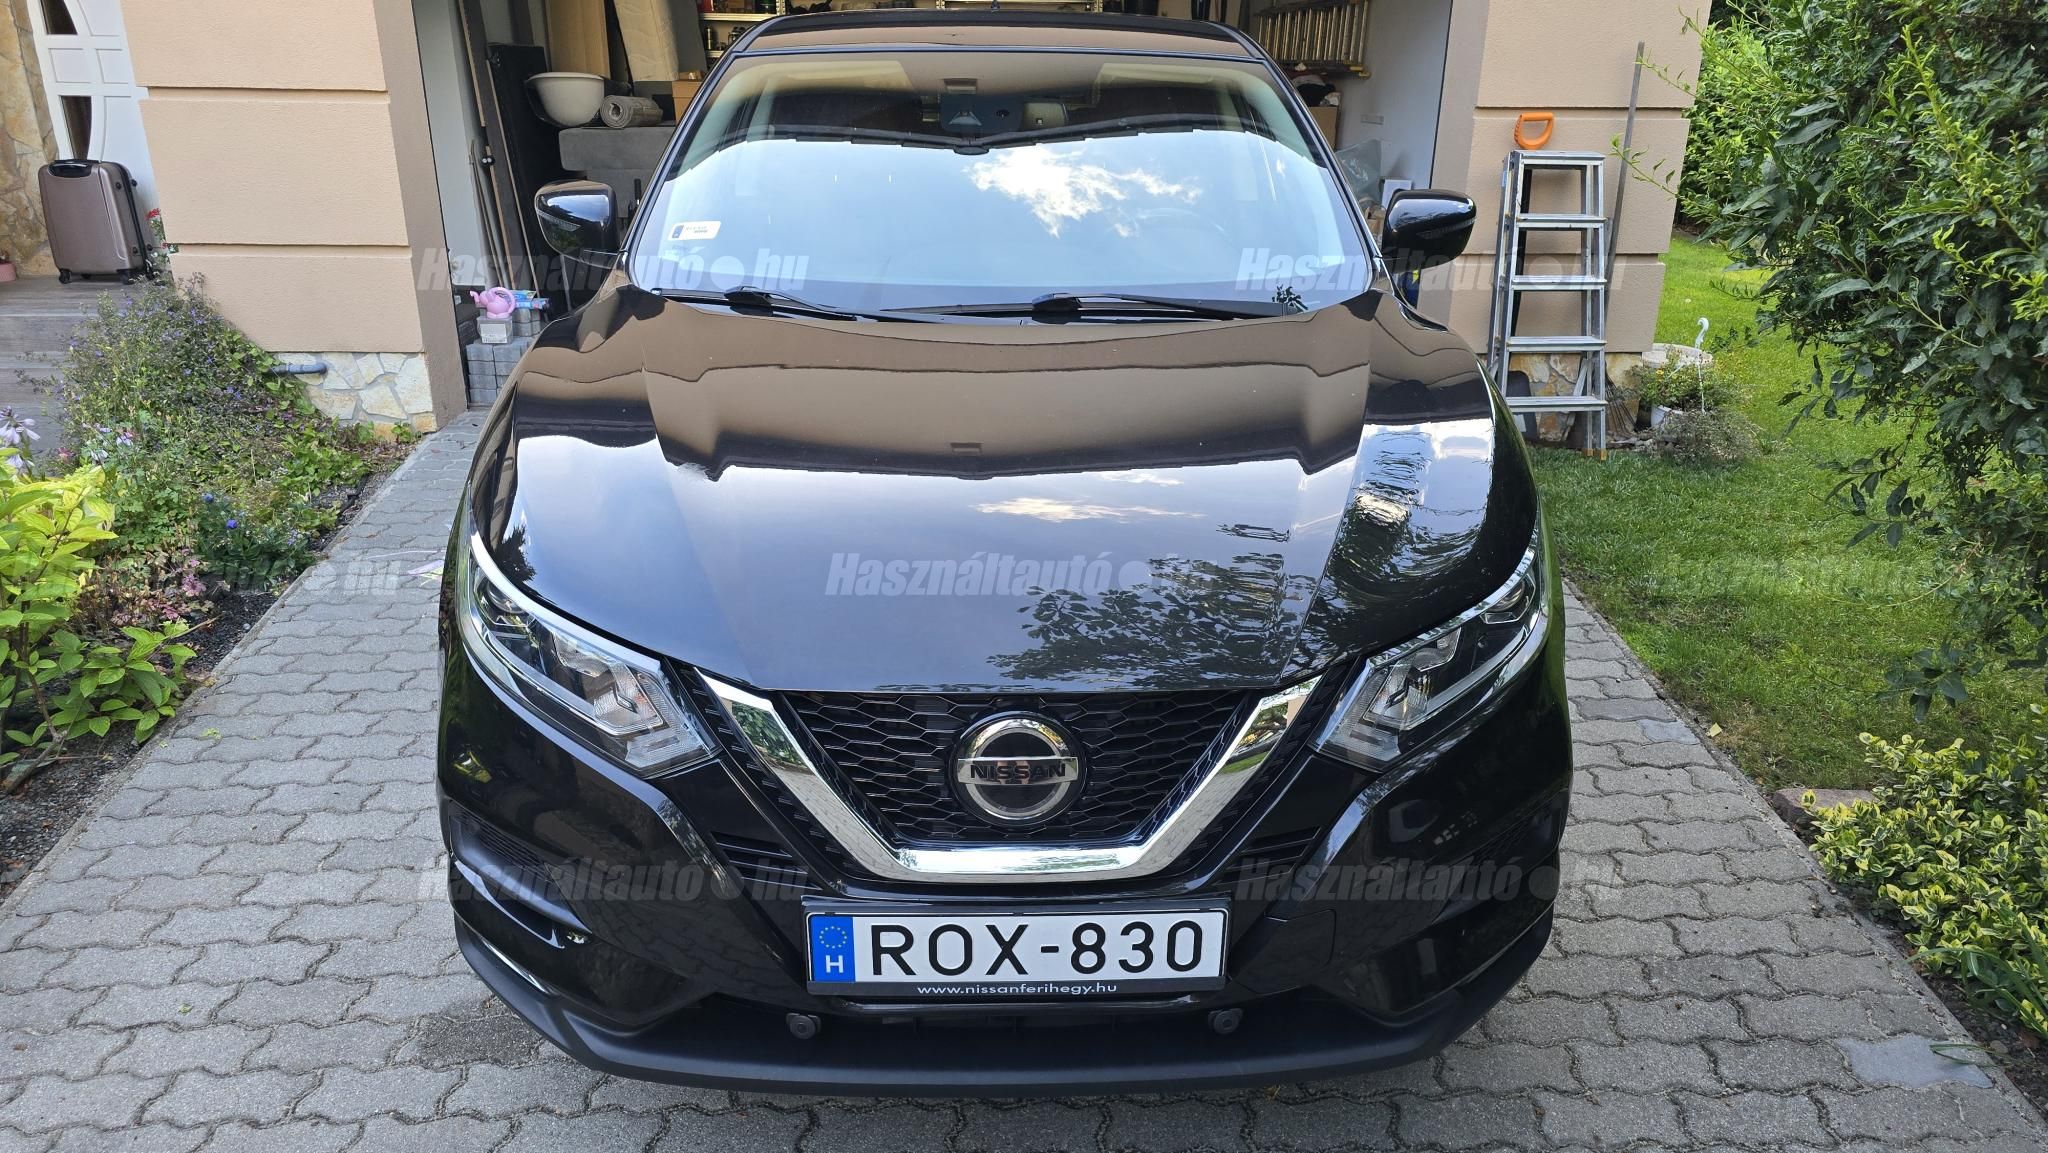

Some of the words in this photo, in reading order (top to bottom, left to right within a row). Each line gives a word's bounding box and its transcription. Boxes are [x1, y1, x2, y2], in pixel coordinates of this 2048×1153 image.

[970, 763, 1066, 780] NISSAN
[870, 919, 1203, 976] ROX-830
[825, 954, 844, 974] H
[917, 982, 1118, 996] www.nissanferihegy.hu
